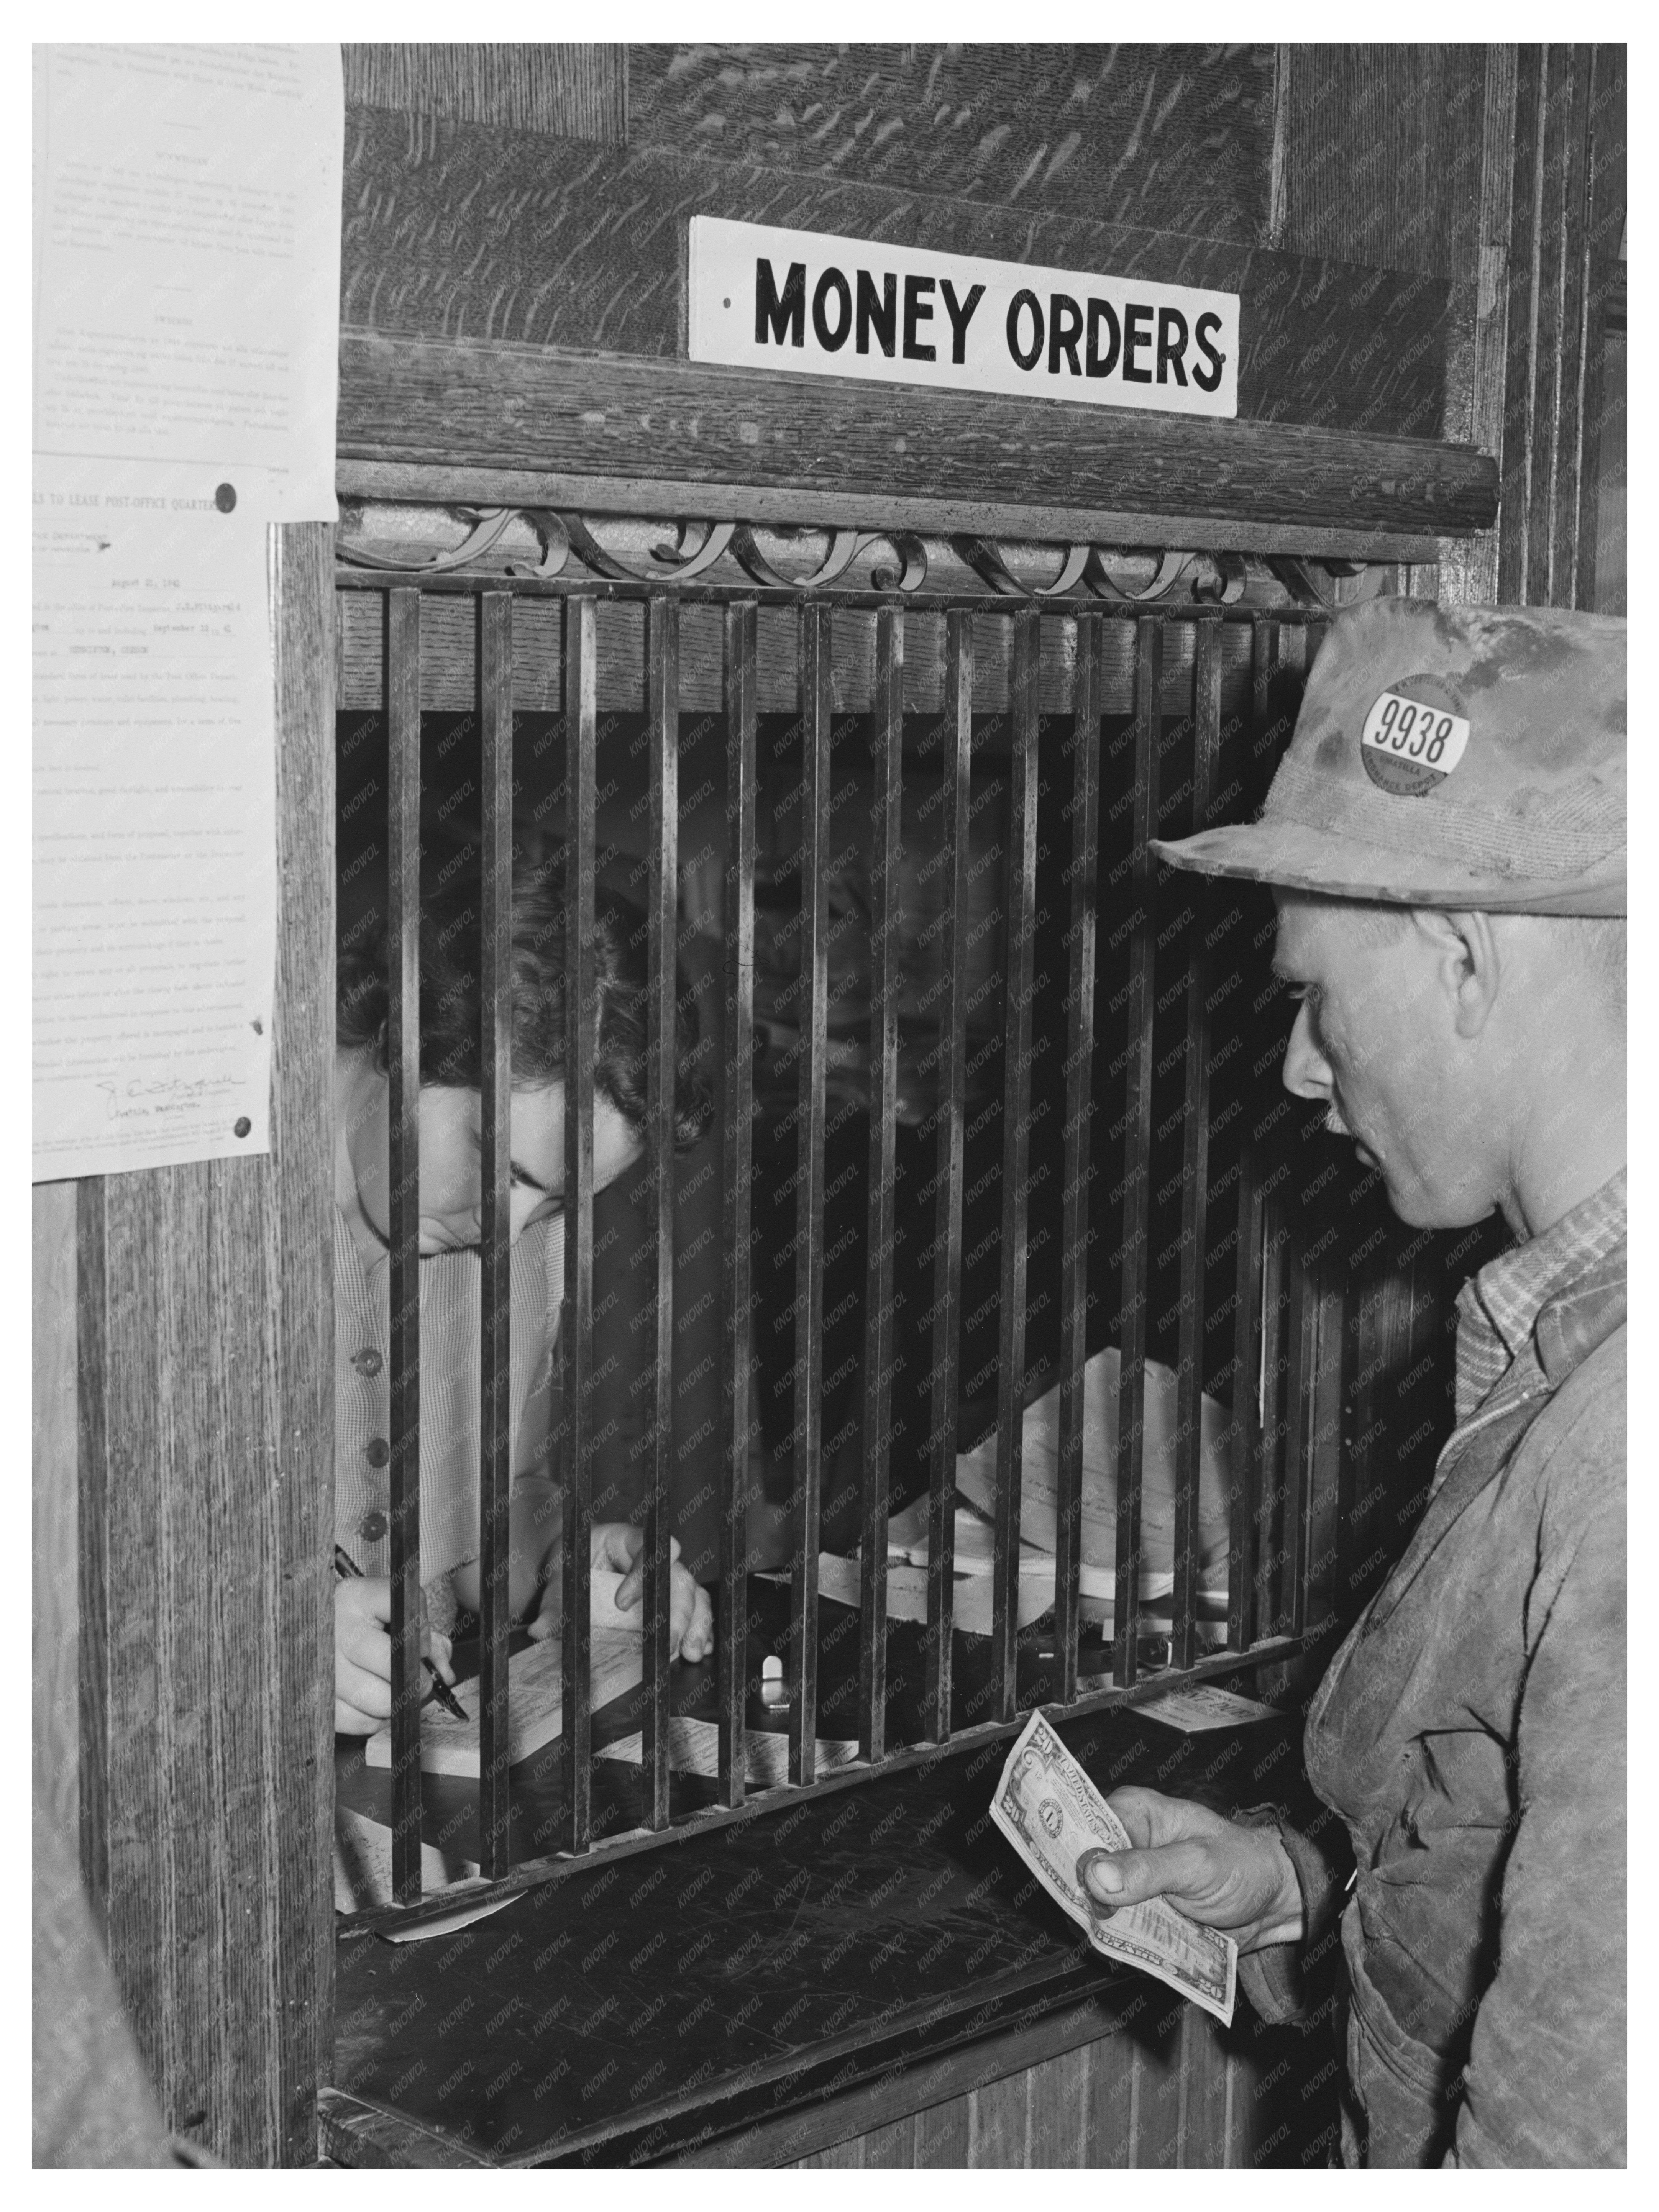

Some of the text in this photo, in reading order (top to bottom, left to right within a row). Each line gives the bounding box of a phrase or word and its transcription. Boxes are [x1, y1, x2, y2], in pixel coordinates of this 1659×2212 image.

[755, 257, 1223, 392] MONEY ORDERS
[51, 493, 64, 505] TO
[69, 494, 99, 507] LEASE
[105, 496, 166, 510] POST-OFFICE
[111, 578, 139, 589] August
[153, 624, 194, 634] September
[1375, 699, 1453, 763] 9938
[1366, 751, 1436, 791] ORDNANCE DEPOT
[1380, 755, 1420, 776] UMATILLA
[1034, 1727, 1053, 1755] 20
[1059, 1756, 1083, 1794] UNITED
[1079, 1793, 1099, 1833] STATES
[1003, 1795, 1019, 1822] 20
[1203, 1927, 1225, 1949] 20
[1198, 1978, 1223, 1999] 20
